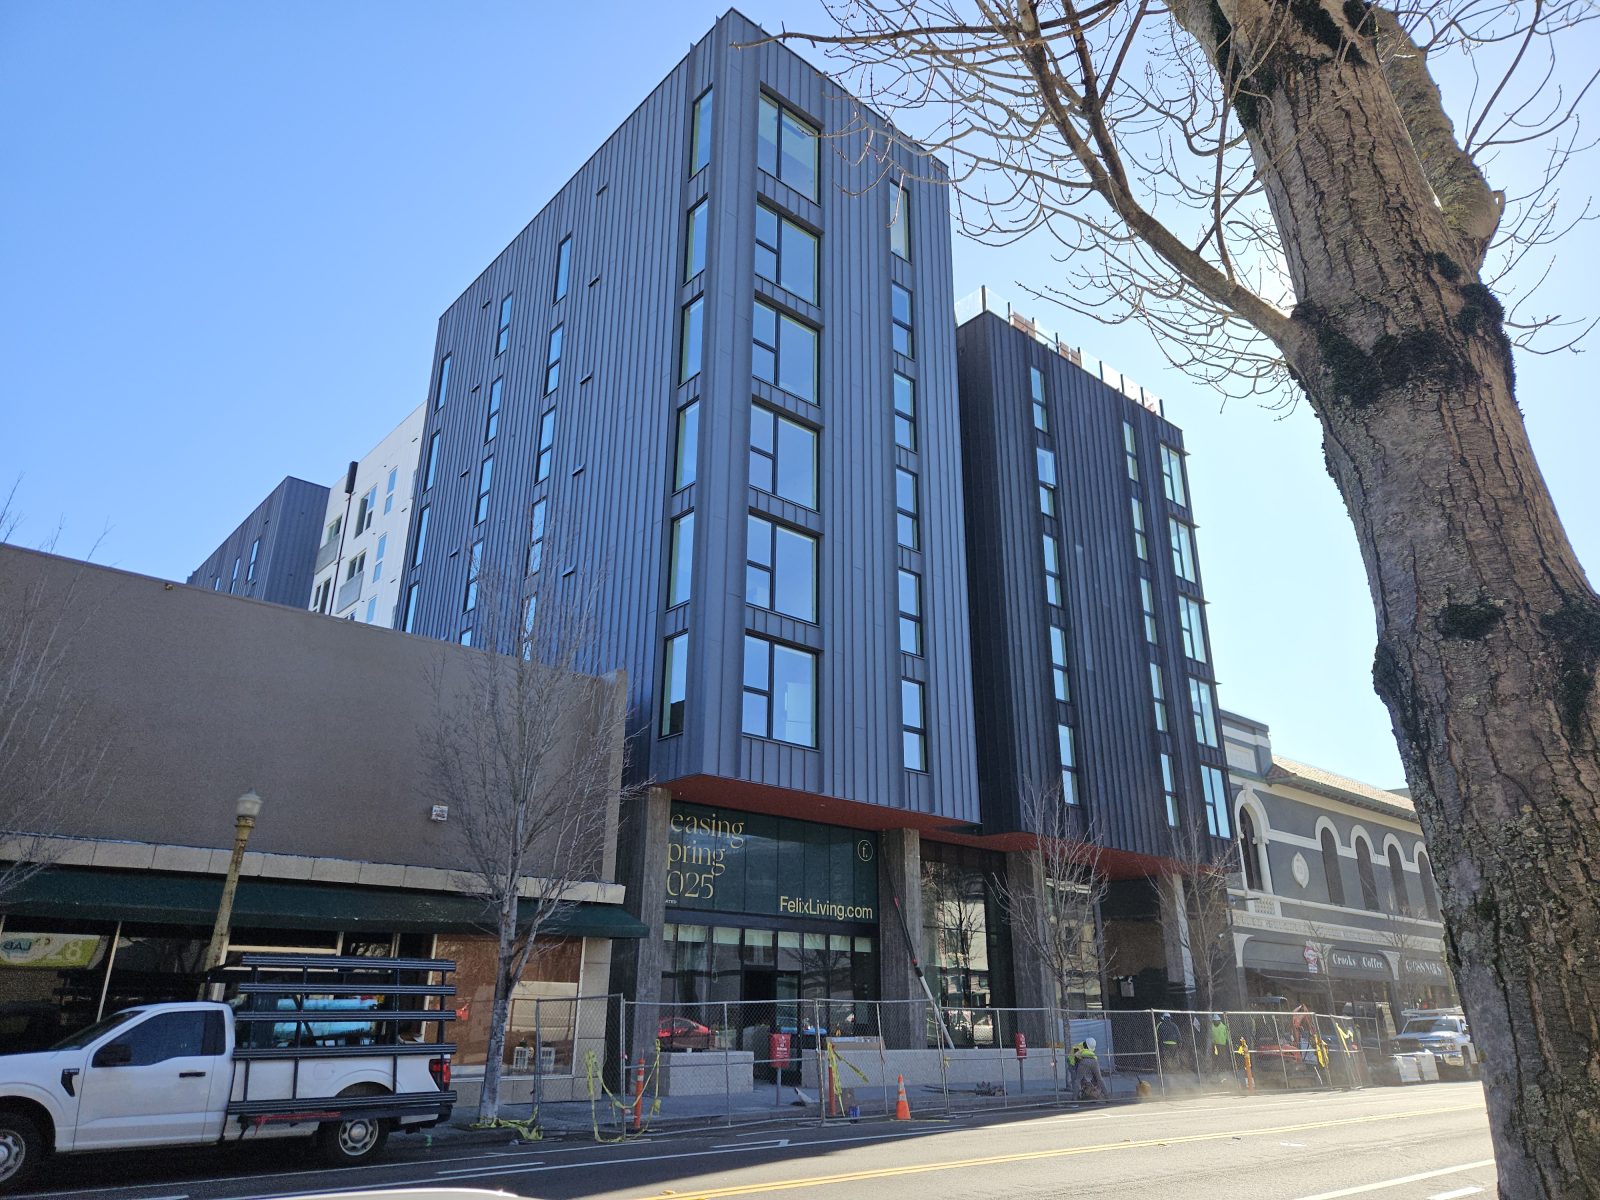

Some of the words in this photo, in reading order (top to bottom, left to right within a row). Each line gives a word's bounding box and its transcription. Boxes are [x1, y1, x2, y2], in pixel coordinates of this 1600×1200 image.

[670, 813, 745, 848] easing
[667, 840, 726, 876] pring
[666, 870, 714, 899] 025
[780, 895, 873, 921] FelixLiving.com
[1362, 956, 1383, 969] Coffee
